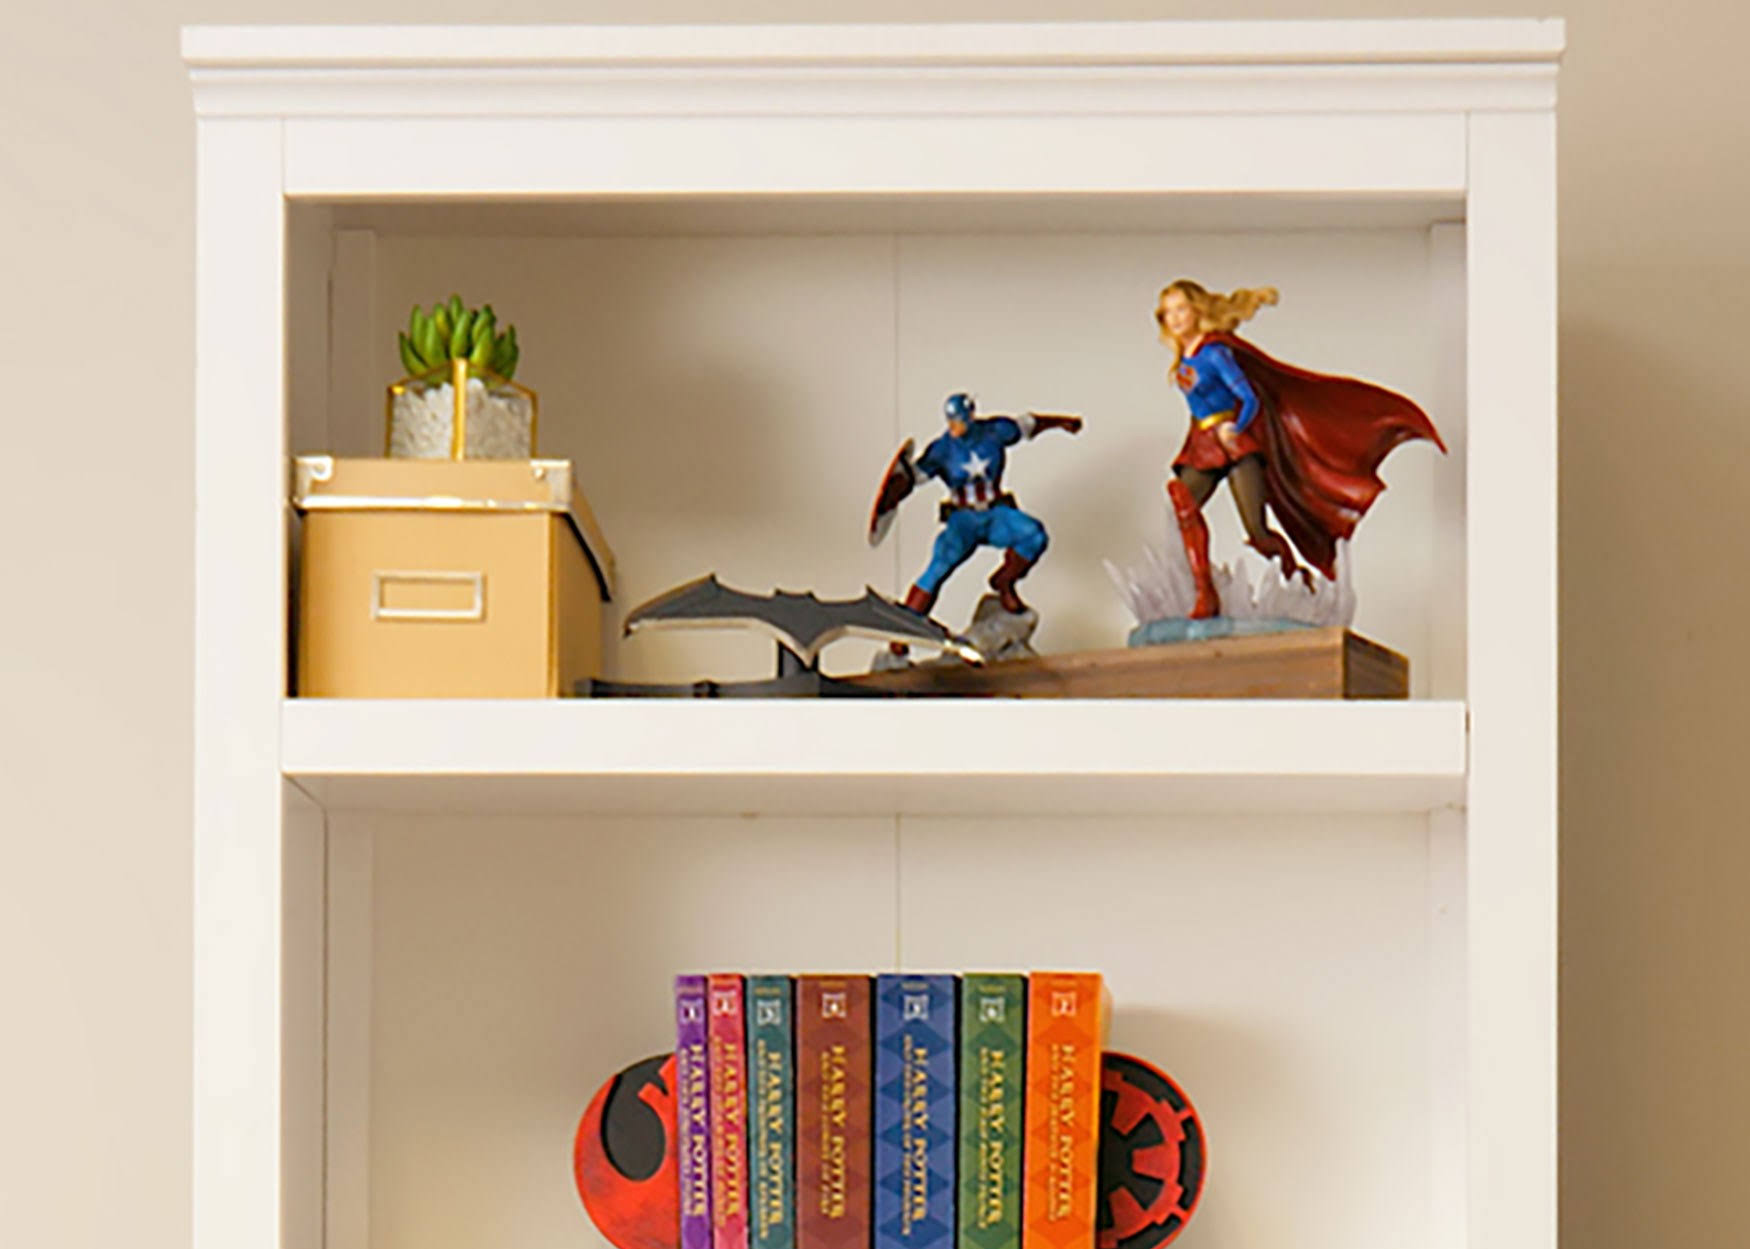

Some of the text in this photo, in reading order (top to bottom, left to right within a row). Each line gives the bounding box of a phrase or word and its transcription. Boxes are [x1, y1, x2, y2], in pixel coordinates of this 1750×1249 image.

[690, 1044, 706, 1217] HARRY POTTER
[767, 1052, 784, 1225] HARRY POTTER
[829, 1046, 847, 1219] HARRY POTTER
[911, 1048, 928, 1221] HARRY POTTER
[987, 1050, 1004, 1224] HARRY POTTER
[1056, 1044, 1076, 1218] HARRY POTTER
